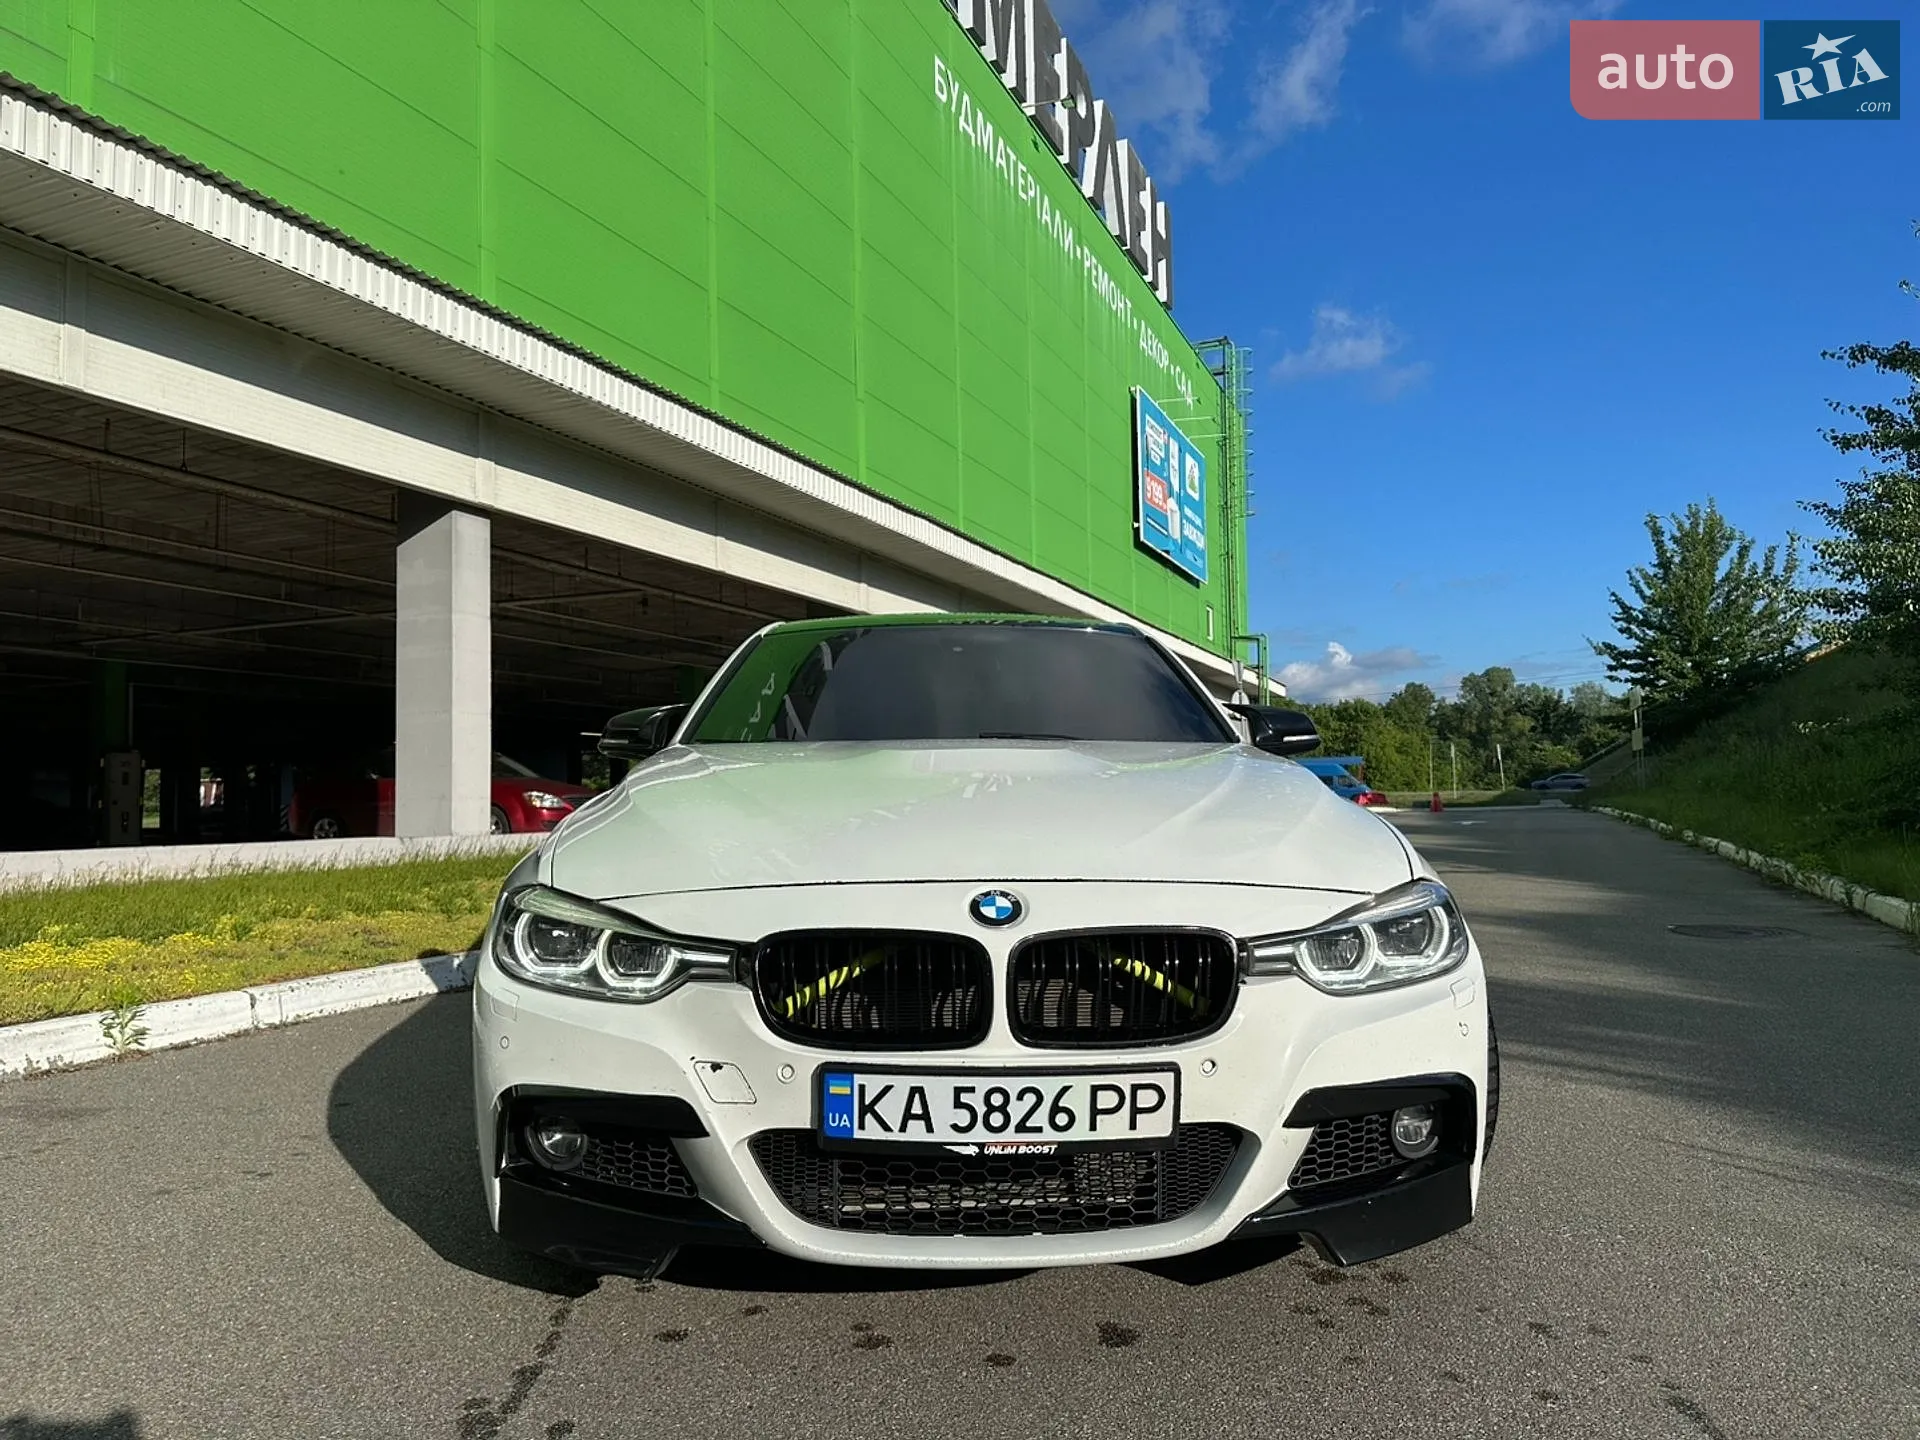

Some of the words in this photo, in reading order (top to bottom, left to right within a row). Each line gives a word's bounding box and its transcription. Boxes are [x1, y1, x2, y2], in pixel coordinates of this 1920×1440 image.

[933, 54, 1074, 261] БУДМАТЕРІАЛИ
[1083, 246, 1133, 329] РЕМОНТ
[1139, 319, 1170, 375] ДЕКОР
[1174, 367, 1195, 411] САД
[829, 1113, 851, 1128] UA
[857, 1083, 935, 1134] KA
[948, 1083, 1077, 1135] 5826
[1088, 1082, 1167, 1132] PP
[1017, 1143, 1058, 1156] BOOST
